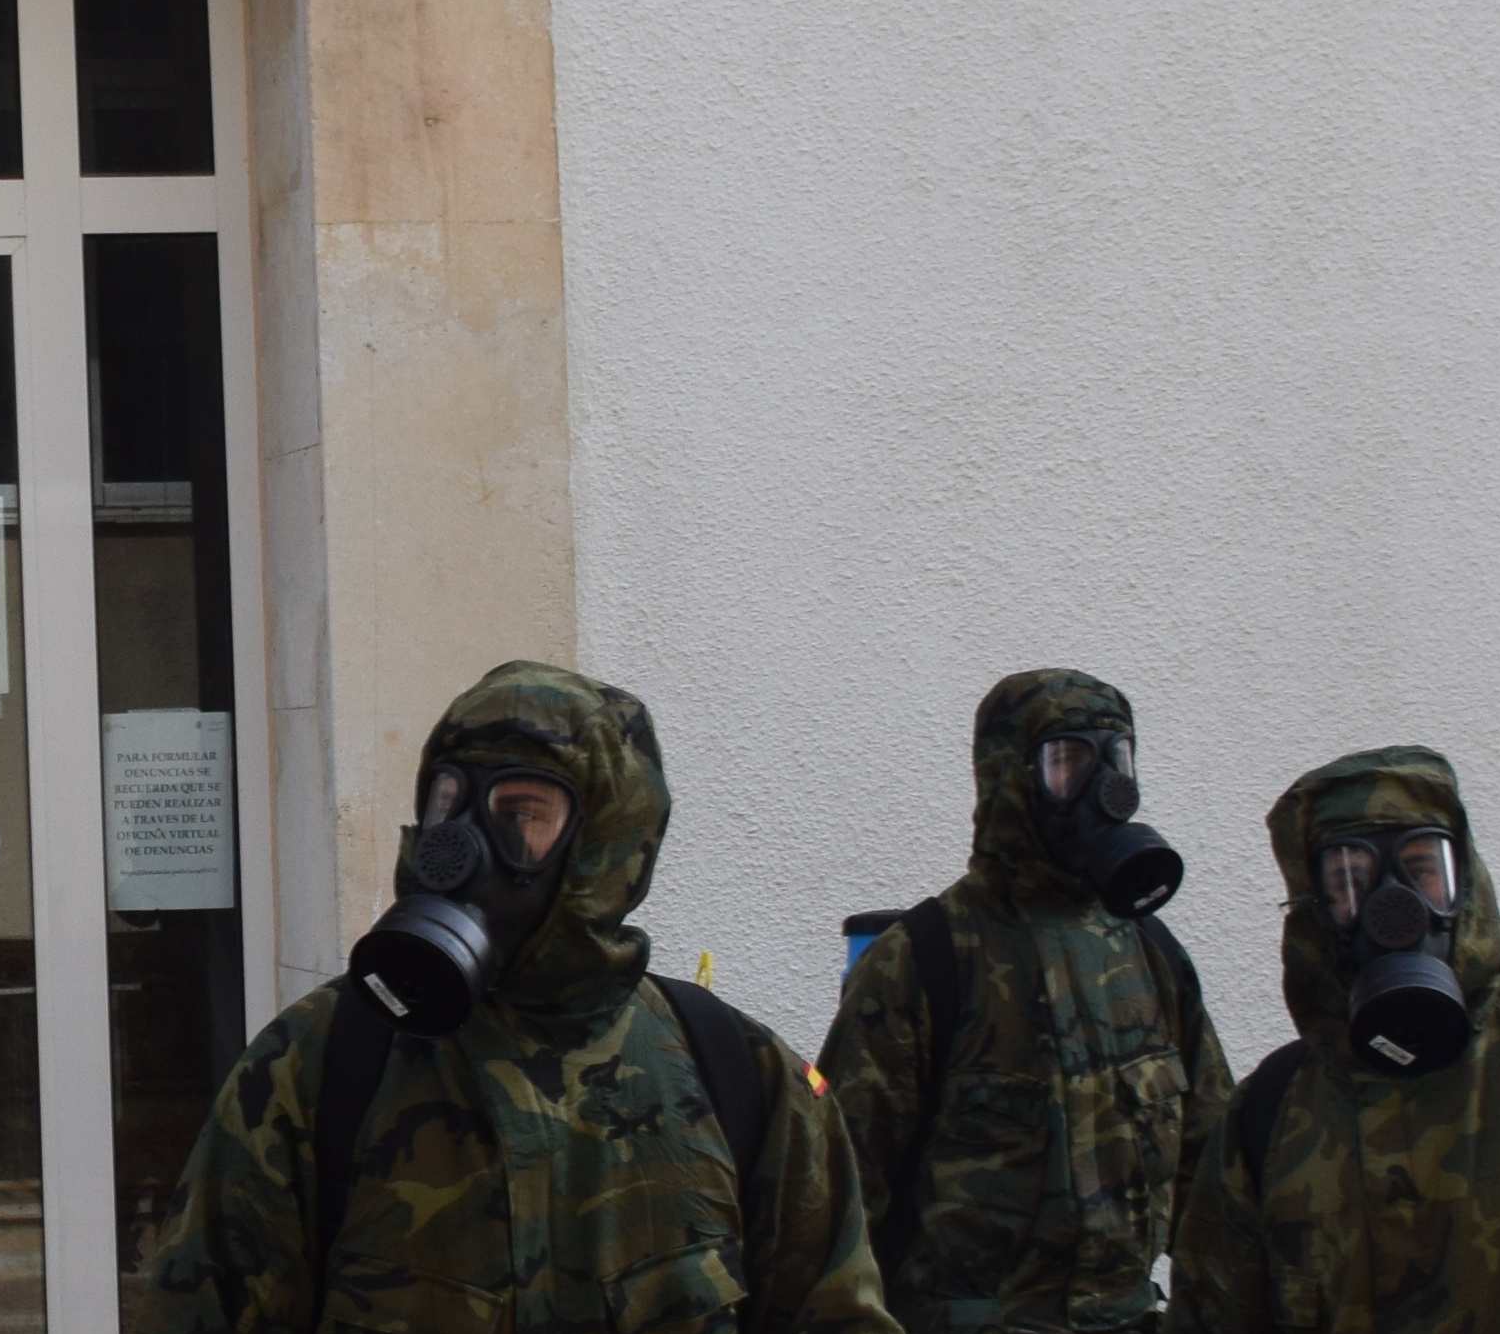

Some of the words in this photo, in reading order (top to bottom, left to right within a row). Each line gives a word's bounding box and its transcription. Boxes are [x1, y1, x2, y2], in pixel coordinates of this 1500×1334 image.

[117, 752, 148, 763] PARA
[151, 751, 217, 762] FORMULAR
[124, 767, 194, 778] DENUNCIAS
[197, 767, 211, 777] SE
[114, 784, 178, 794] RECUERDA
[180, 783, 204, 794] QUE
[207, 782, 221, 792] SE
[114, 799, 161, 809] PUEDEN
[164, 798, 221, 809] REALIZAR
[122, 816, 130, 825] A
[181, 814, 197, 824] DE
[200, 814, 216, 823] LA
[116, 830, 166, 841] OFICINA
[169, 829, 220, 839] VIRTUAL
[124, 846, 141, 856] DE
[143, 844, 215, 856] DENUNCIAS
